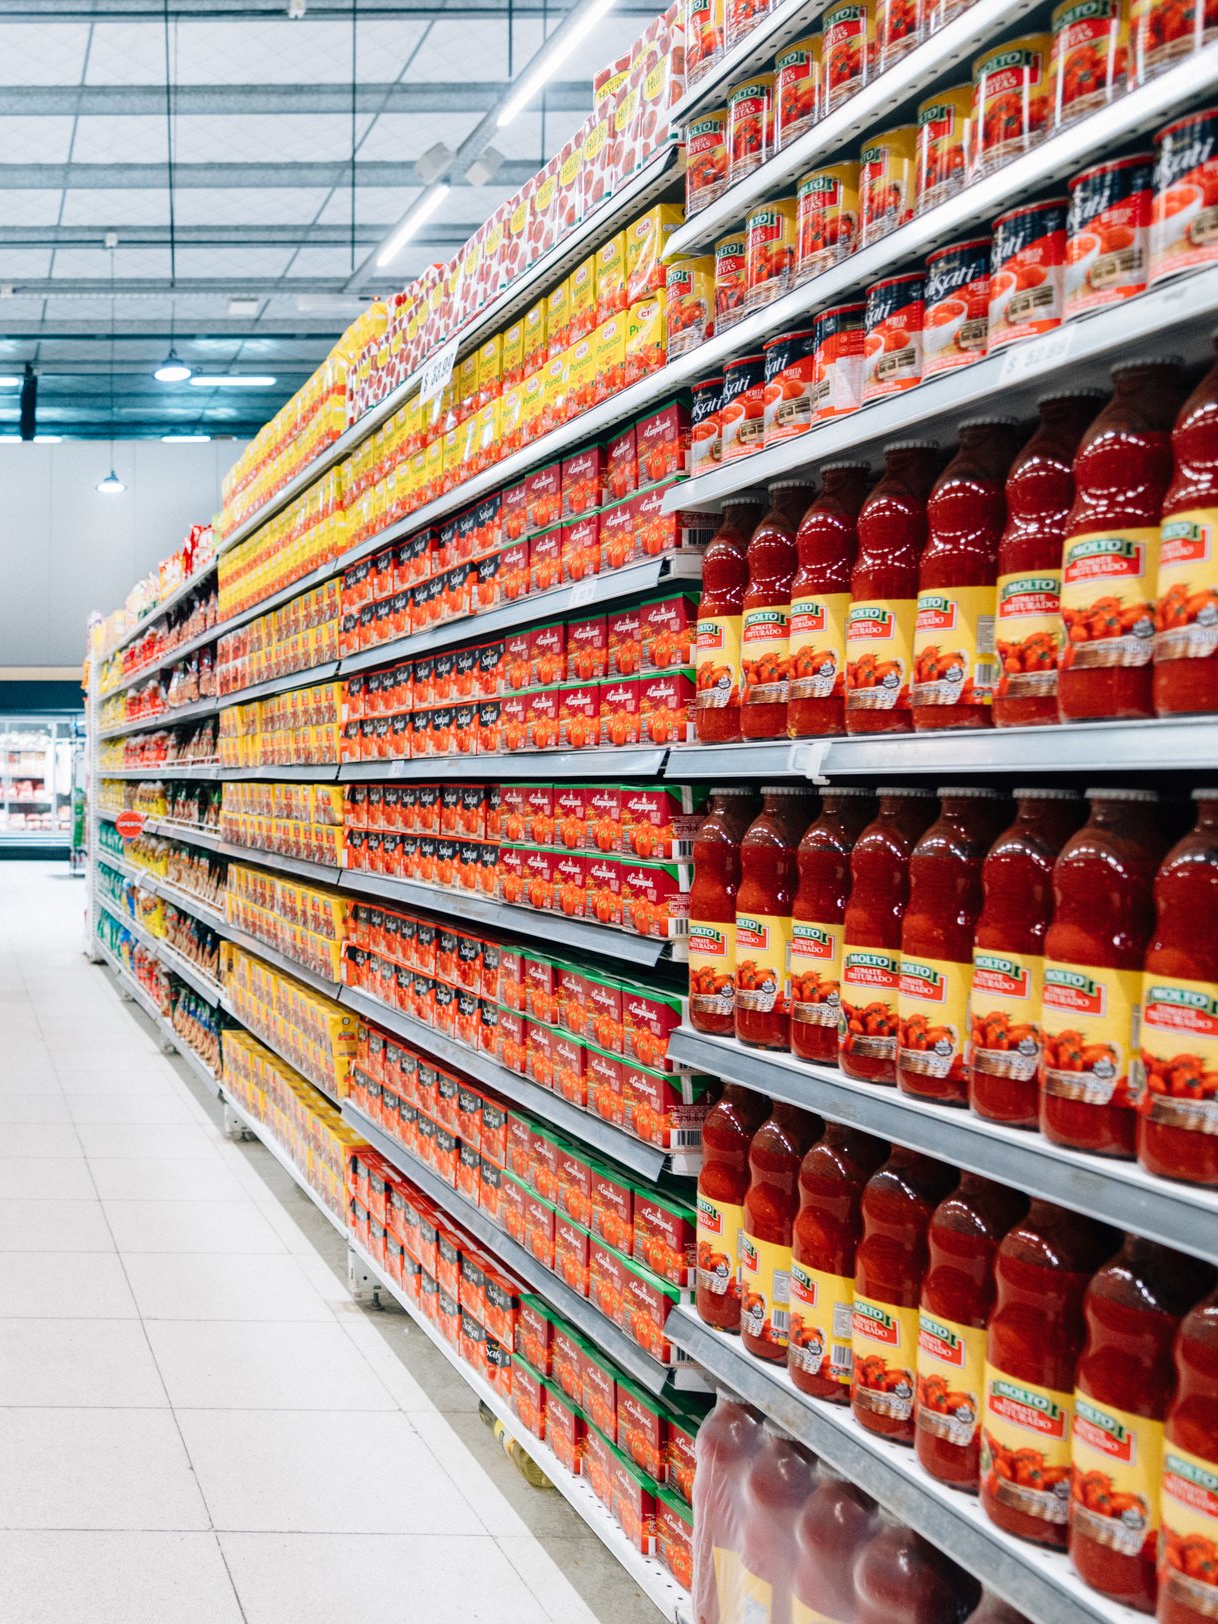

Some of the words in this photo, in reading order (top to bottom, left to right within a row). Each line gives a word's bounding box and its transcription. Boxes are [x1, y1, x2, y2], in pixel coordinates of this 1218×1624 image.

[1073, 540, 1122, 555] MOLTO
[1009, 580, 1054, 591] MOLTO
[748, 612, 778, 622] MOLTO
[851, 954, 888, 966] MOLTO
[1152, 988, 1208, 1006] MOLTO
[998, 1382, 1048, 1409] MOLTO
